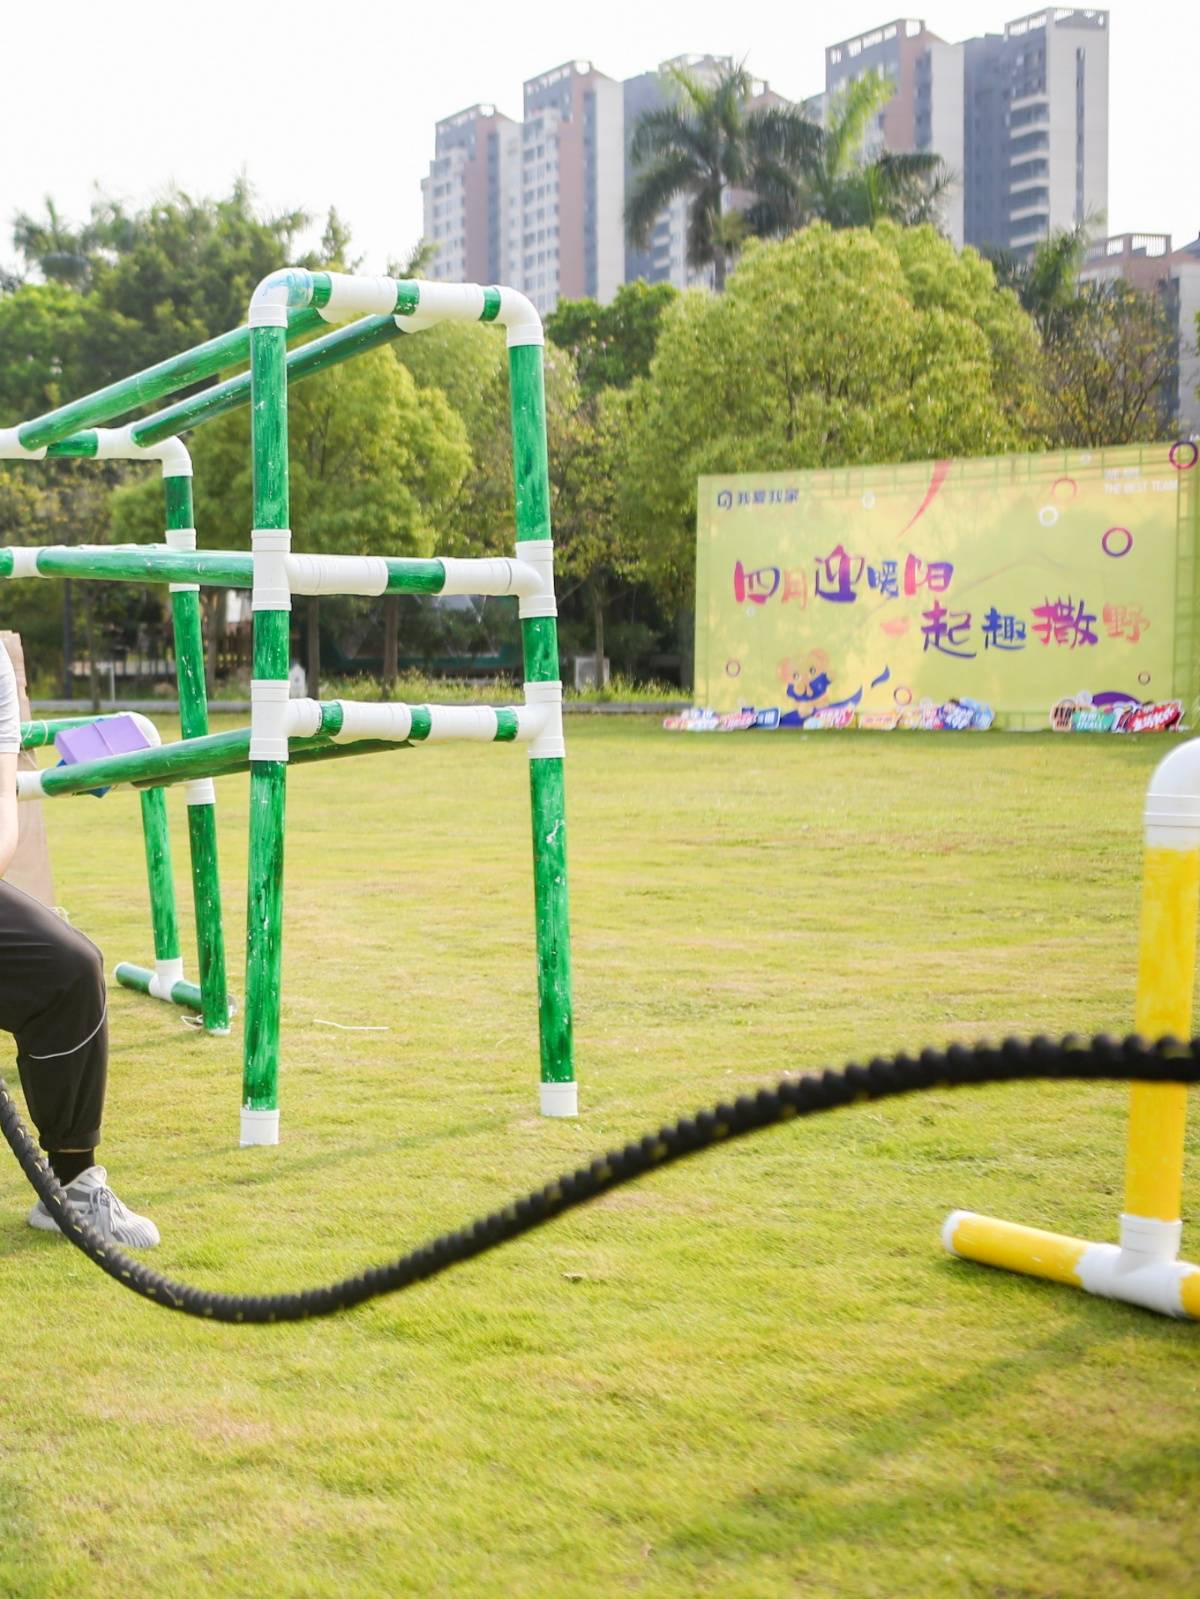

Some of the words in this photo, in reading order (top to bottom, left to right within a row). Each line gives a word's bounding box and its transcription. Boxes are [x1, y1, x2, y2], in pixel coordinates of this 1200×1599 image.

[734, 545, 954, 611] 四月迎暖阳
